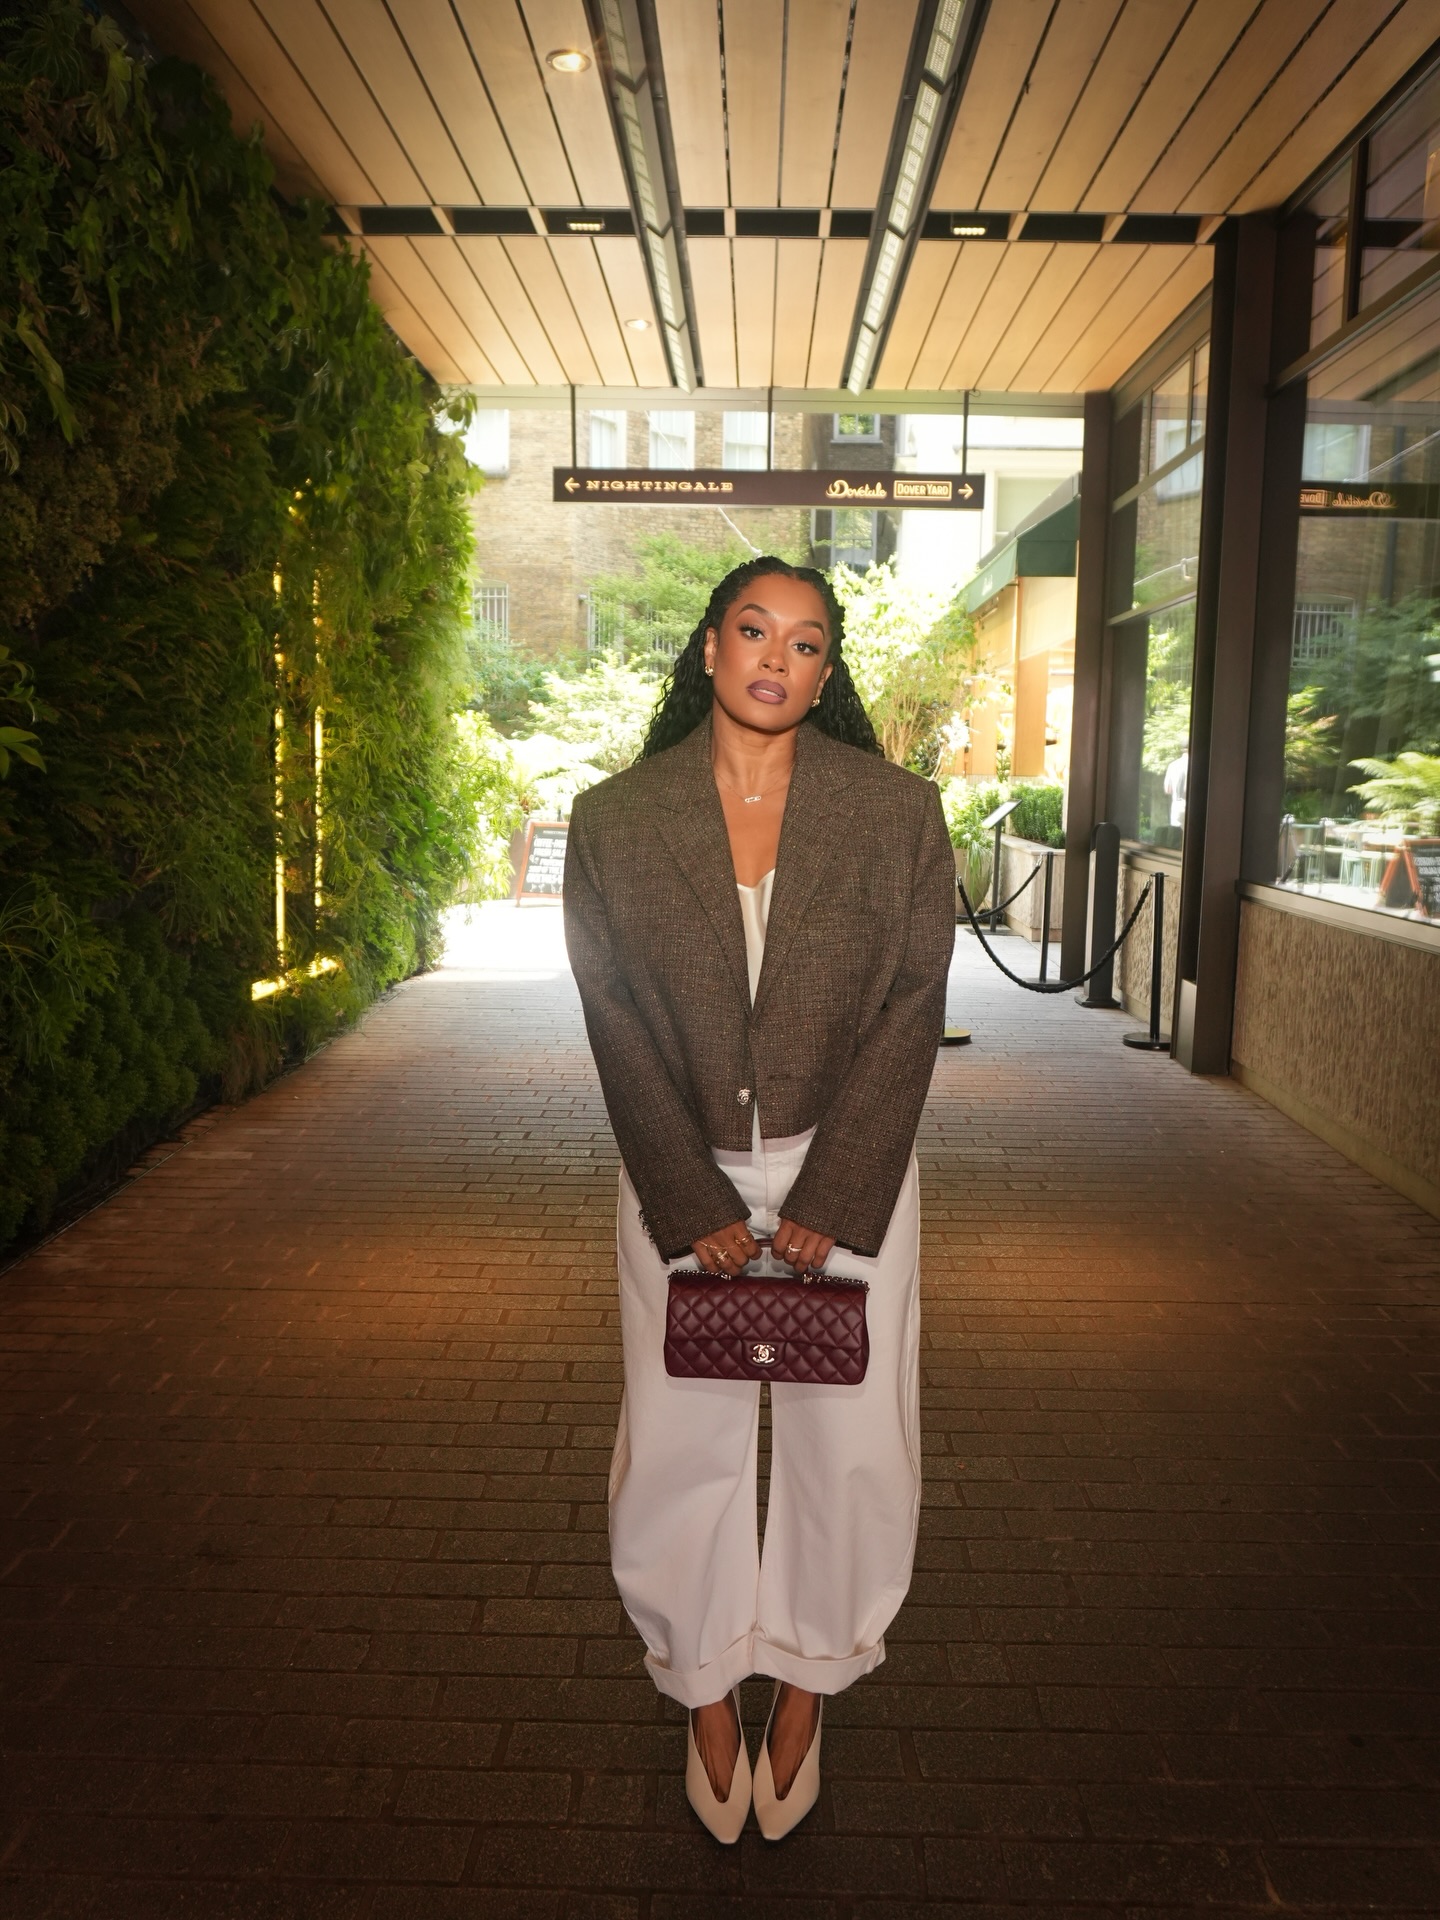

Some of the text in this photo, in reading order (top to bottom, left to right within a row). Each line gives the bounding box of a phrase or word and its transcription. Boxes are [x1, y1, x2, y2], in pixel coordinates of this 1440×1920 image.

[586, 480, 734, 493] NIGHTINGALE
[825, 479, 887, 499] Dovetale
[897, 483, 949, 496] DOVER YARD
